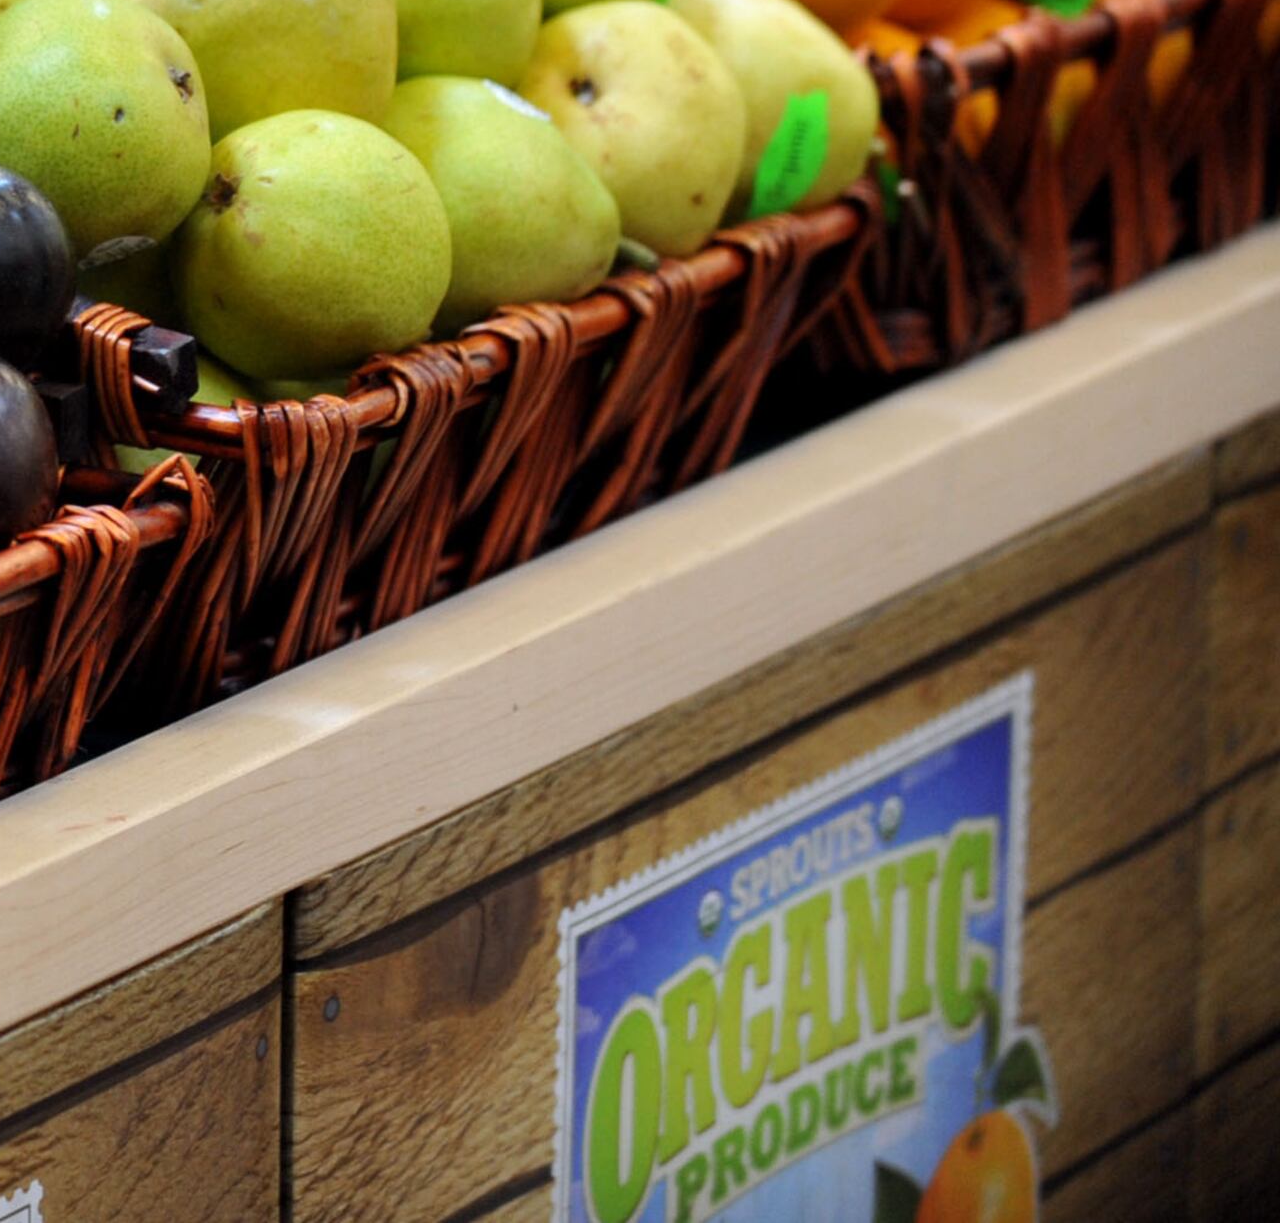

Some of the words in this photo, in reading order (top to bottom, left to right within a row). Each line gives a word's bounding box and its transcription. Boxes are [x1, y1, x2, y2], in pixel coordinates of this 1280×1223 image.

[730, 802, 874, 920] SPROUTS
[588, 825, 994, 1223] ORGANIC
[674, 1037, 918, 1223] PRODUCE
